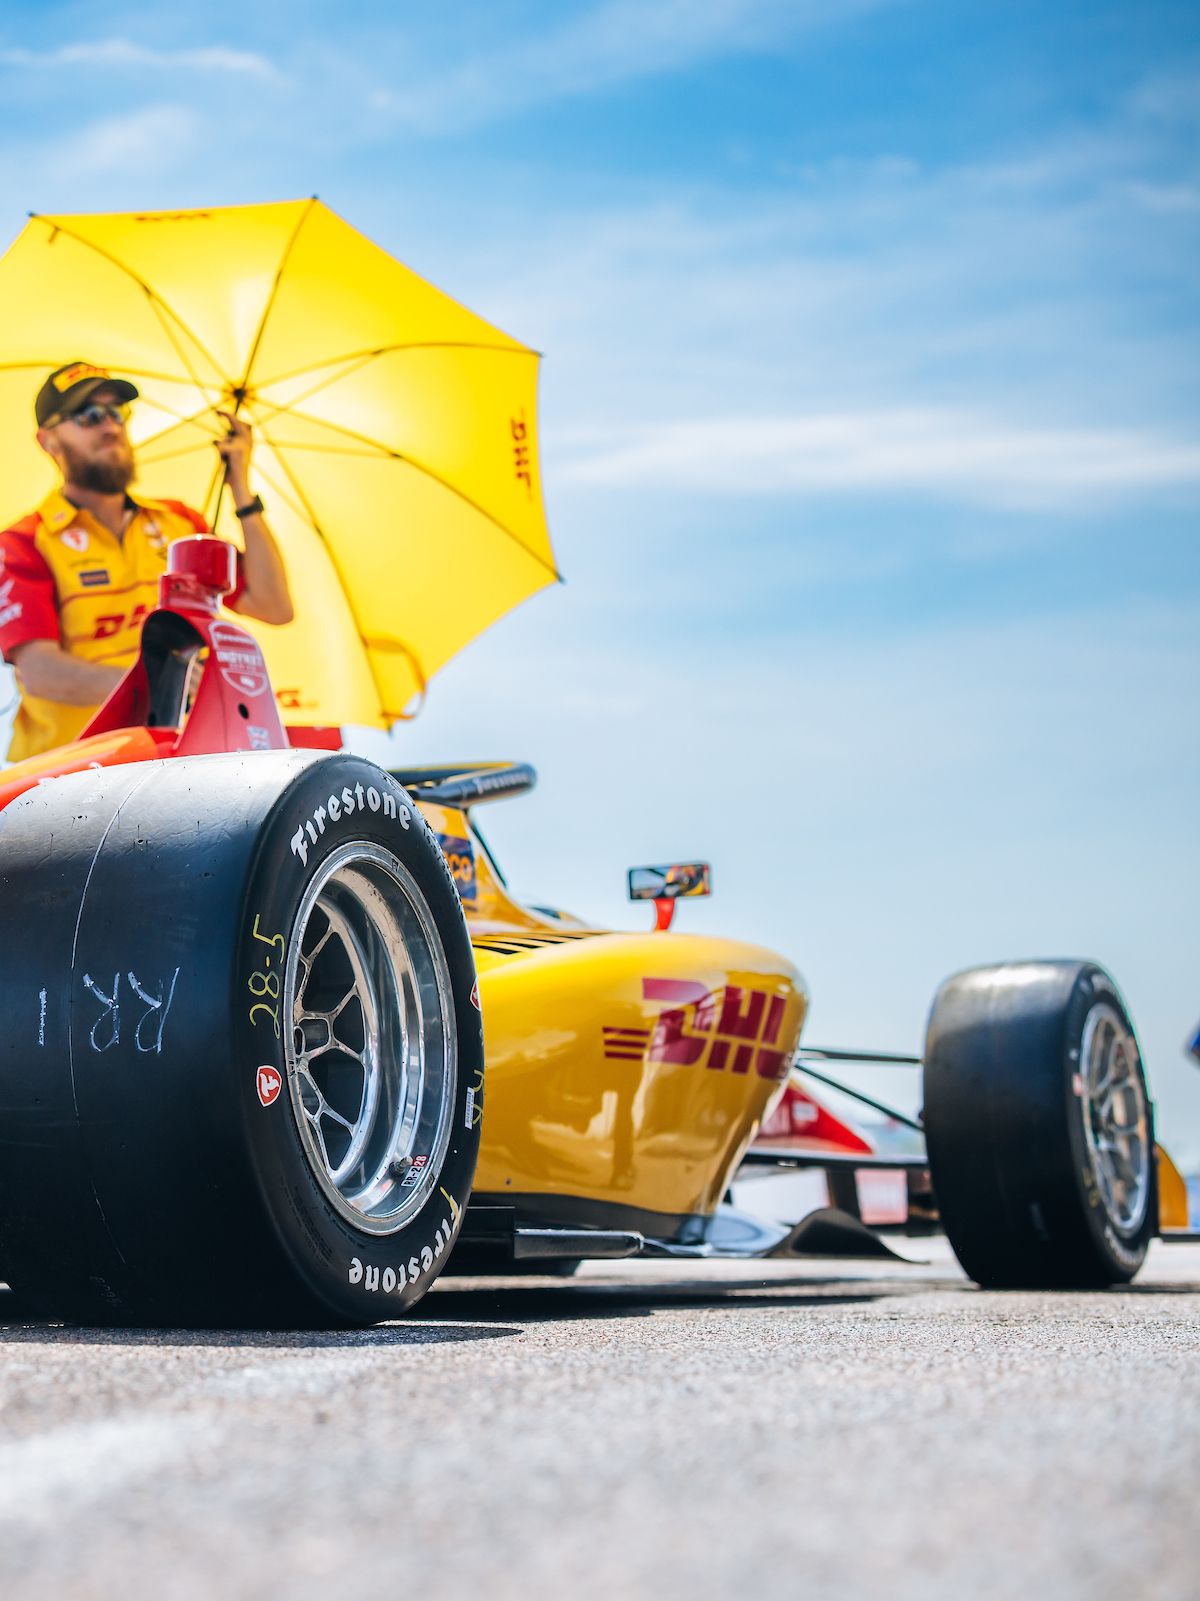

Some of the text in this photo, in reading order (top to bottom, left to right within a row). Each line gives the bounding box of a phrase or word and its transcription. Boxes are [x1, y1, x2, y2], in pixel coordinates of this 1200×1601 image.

[290, 781, 412, 867] Firestone
[248, 914, 286, 1040] 28-5
[642, 977, 790, 1080] DHL
[349, 1195, 463, 1294] Firestone
